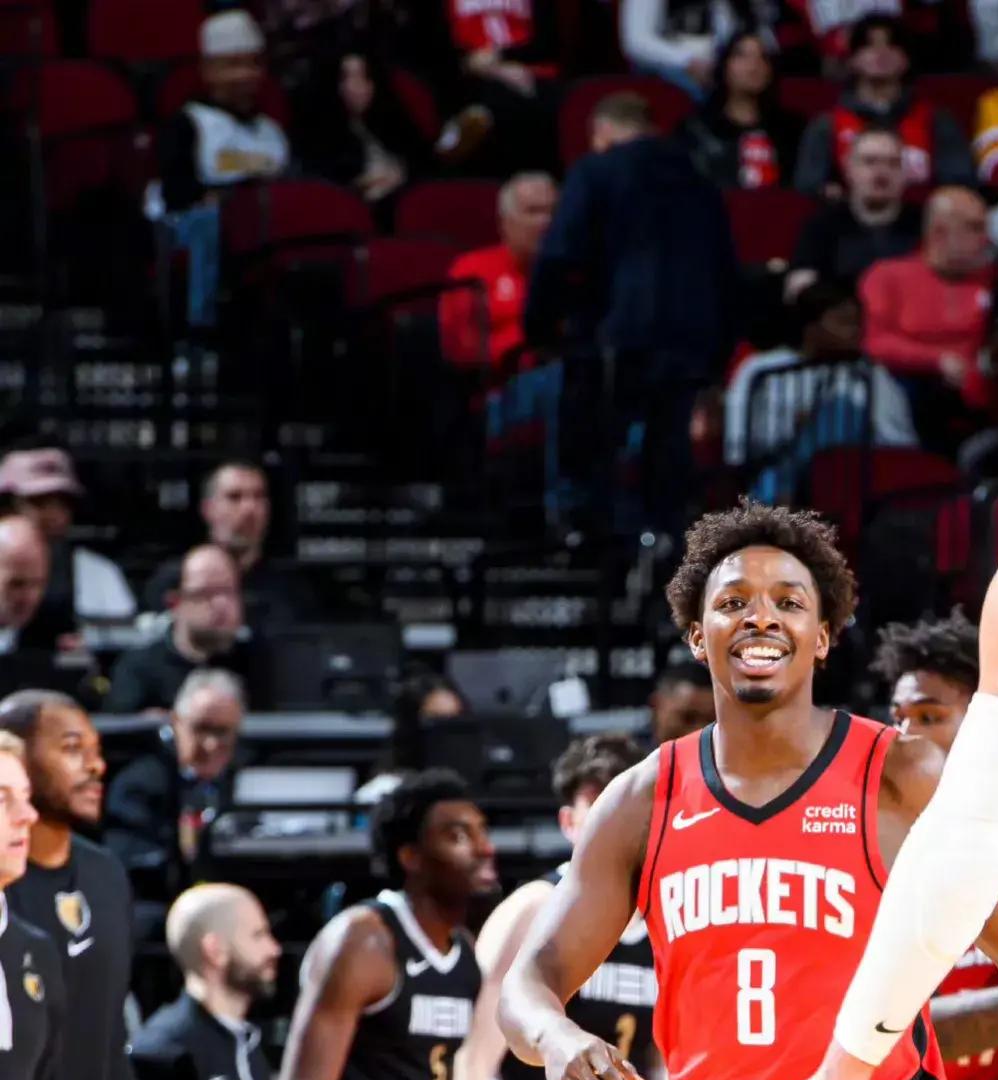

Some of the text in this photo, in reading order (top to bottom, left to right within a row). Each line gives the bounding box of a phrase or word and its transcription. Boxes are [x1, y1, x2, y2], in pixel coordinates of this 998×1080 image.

[802, 817, 857, 833] karma
[805, 803, 857, 819] credit
[660, 857, 856, 944] ROCKETS
[737, 948, 777, 1045] 8
